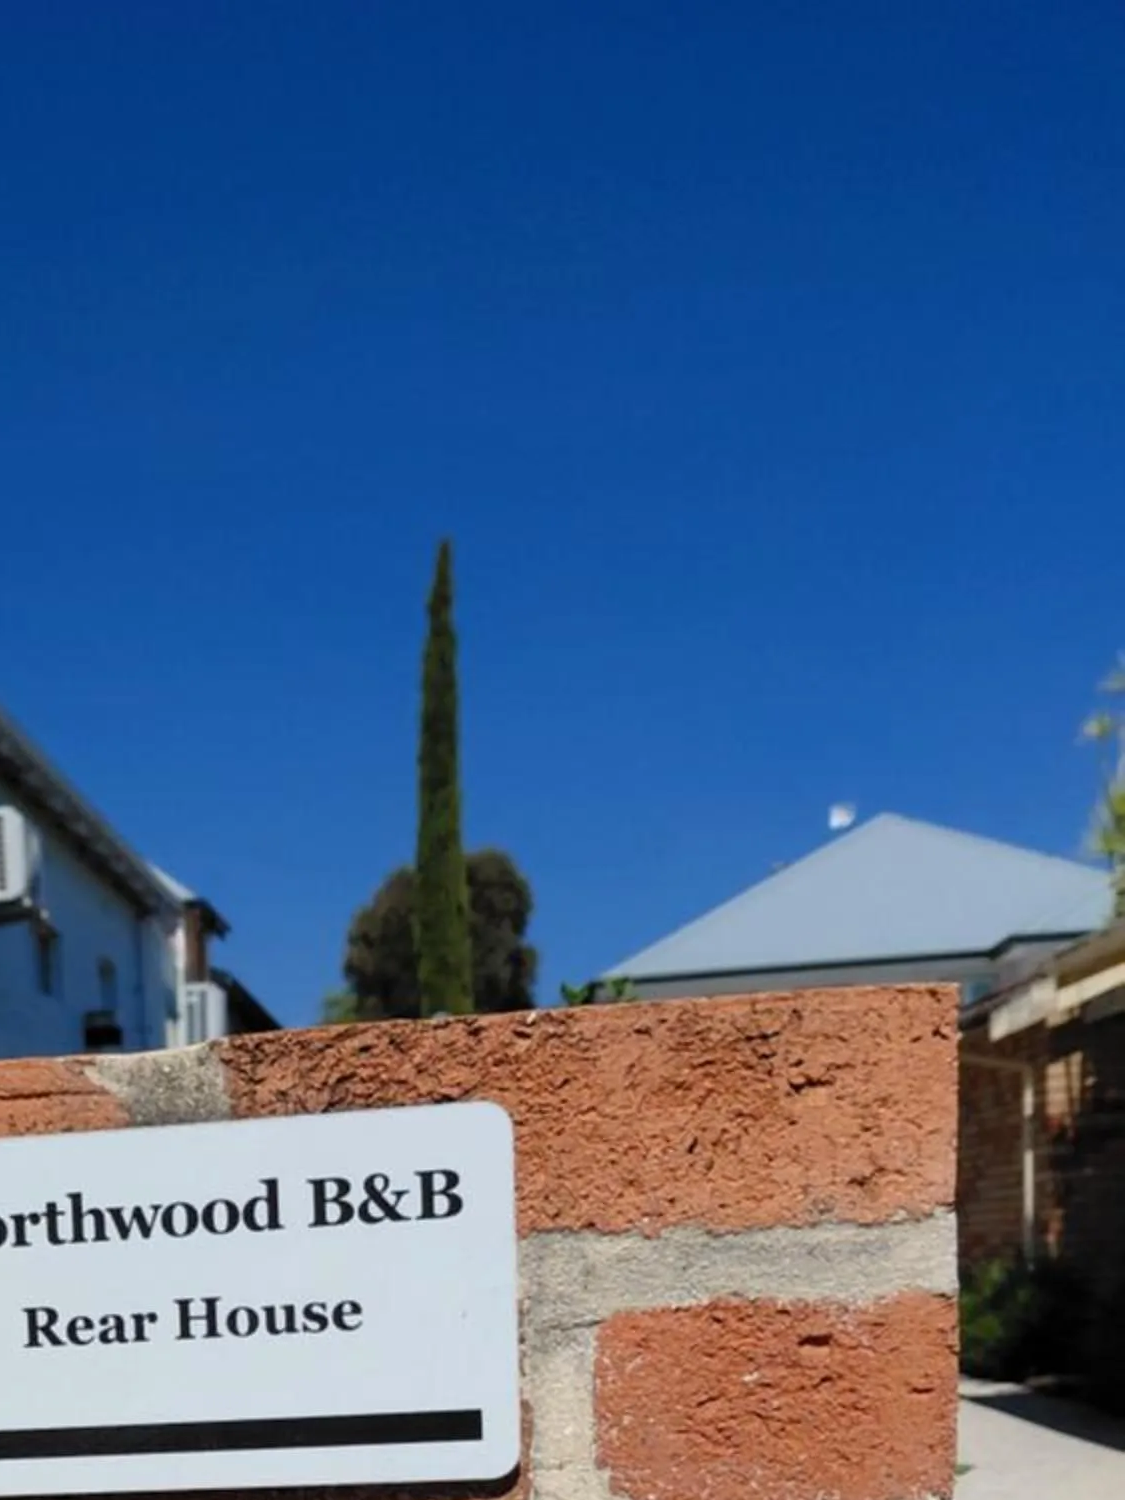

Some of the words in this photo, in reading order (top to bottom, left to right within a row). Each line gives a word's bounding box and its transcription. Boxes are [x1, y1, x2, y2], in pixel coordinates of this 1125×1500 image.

[308, 1169, 464, 1228] B&B
[23, 1306, 158, 1348] Rear
[174, 1297, 363, 1340] House
